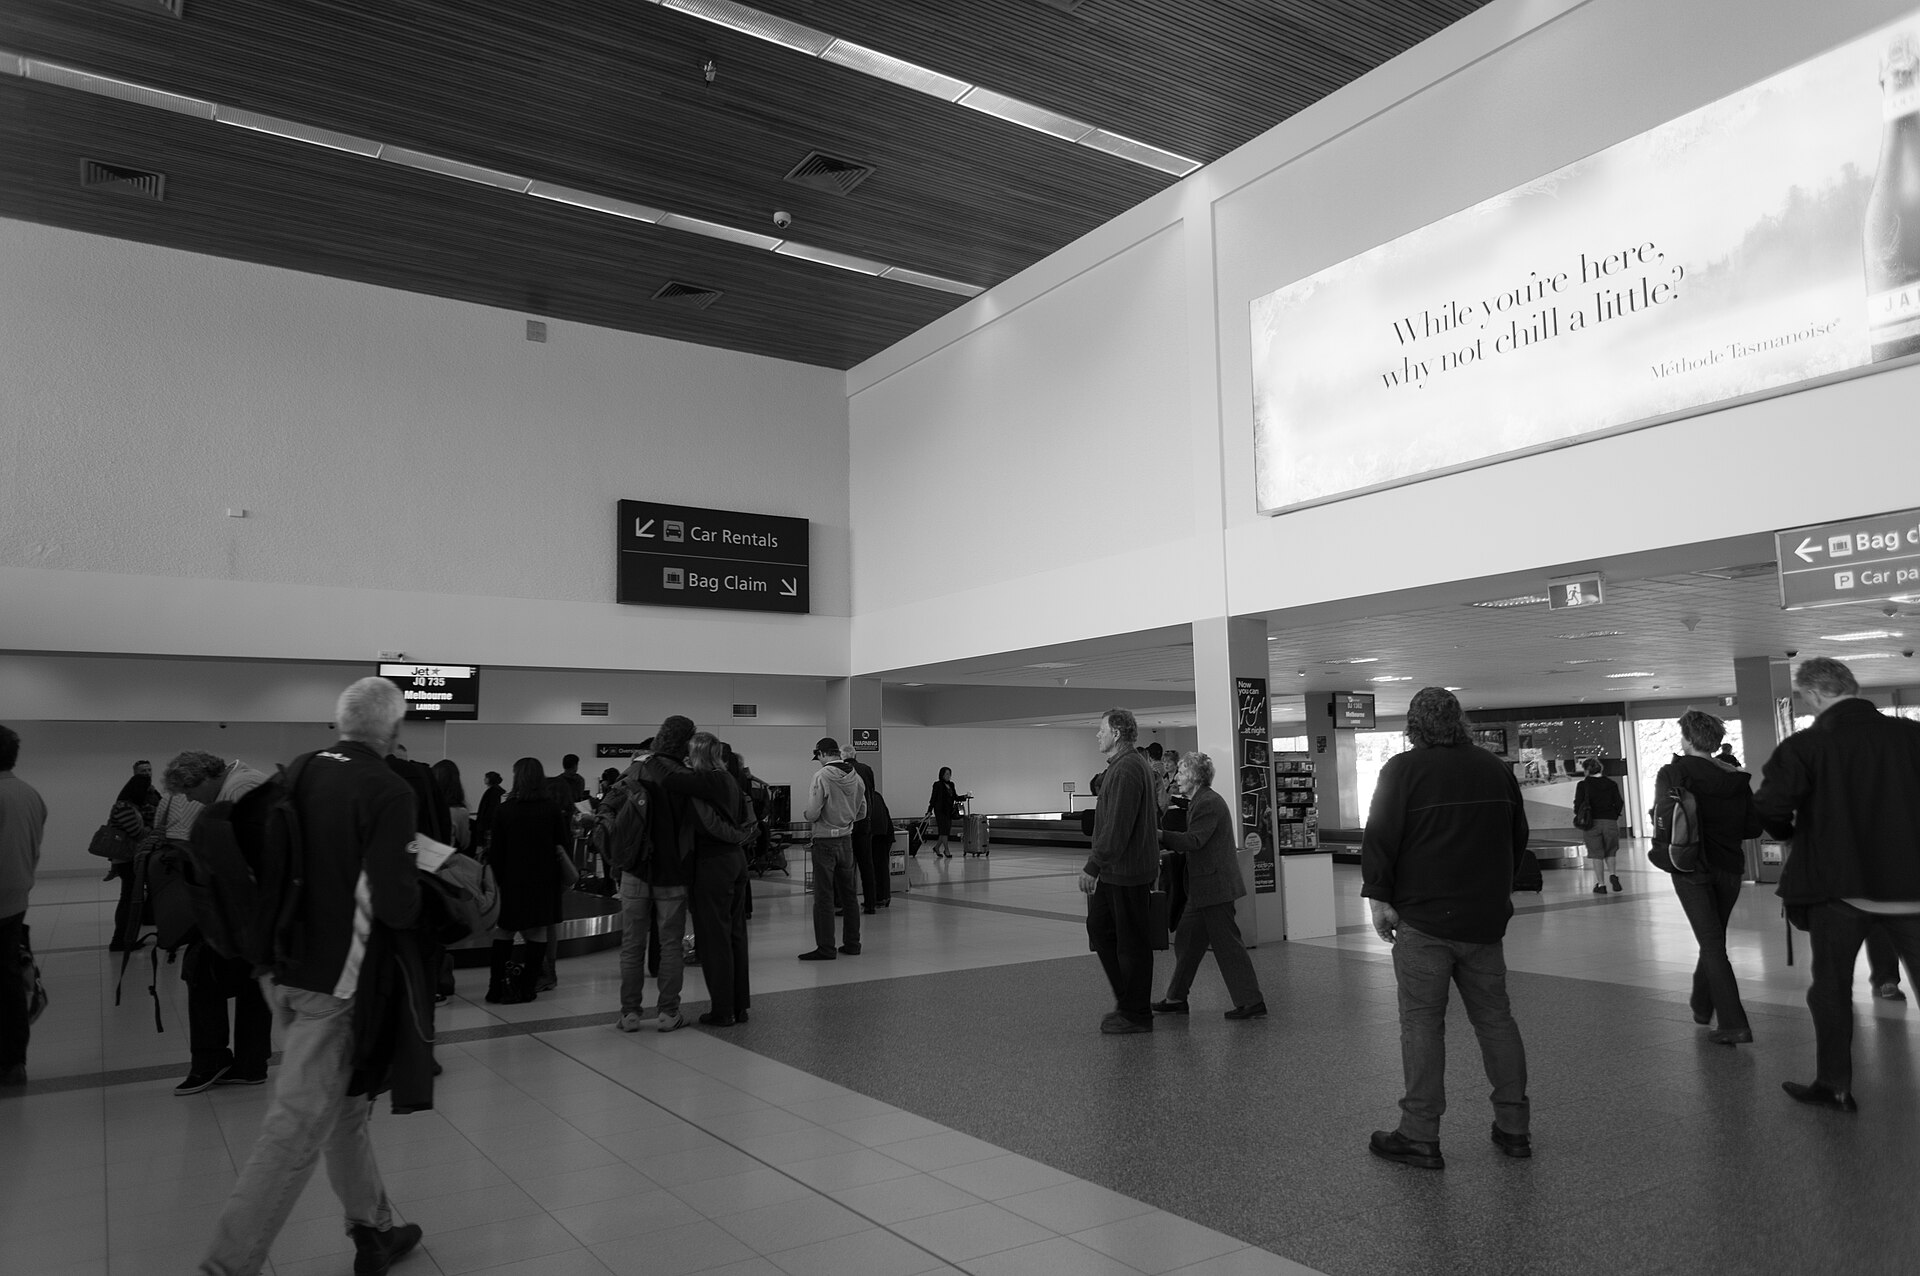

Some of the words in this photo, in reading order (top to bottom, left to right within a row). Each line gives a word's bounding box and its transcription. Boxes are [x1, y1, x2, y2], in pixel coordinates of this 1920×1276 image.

[1393, 300, 1473, 346] While
[1480, 271, 1568, 329] you're
[1578, 241, 1665, 285] here,
[1382, 356, 1434, 389] why
[1441, 338, 1488, 372] not
[1495, 307, 1561, 354] chill
[1569, 310, 1587, 331] a
[1594, 264, 1684, 322] little?
[1651, 350, 1725, 379] Méthode
[690, 526, 717, 542] Car
[722, 529, 778, 548] Rentals
[1856, 531, 1899, 551] Bag
[688, 572, 719, 592] Bag
[724, 575, 767, 591] Claim
[1860, 571, 1890, 585] Car
[411, 667, 430, 676] Jet
[412, 677, 426, 687] JQ
[428, 677, 446, 687] 735
[404, 690, 453, 700] Melbourne
